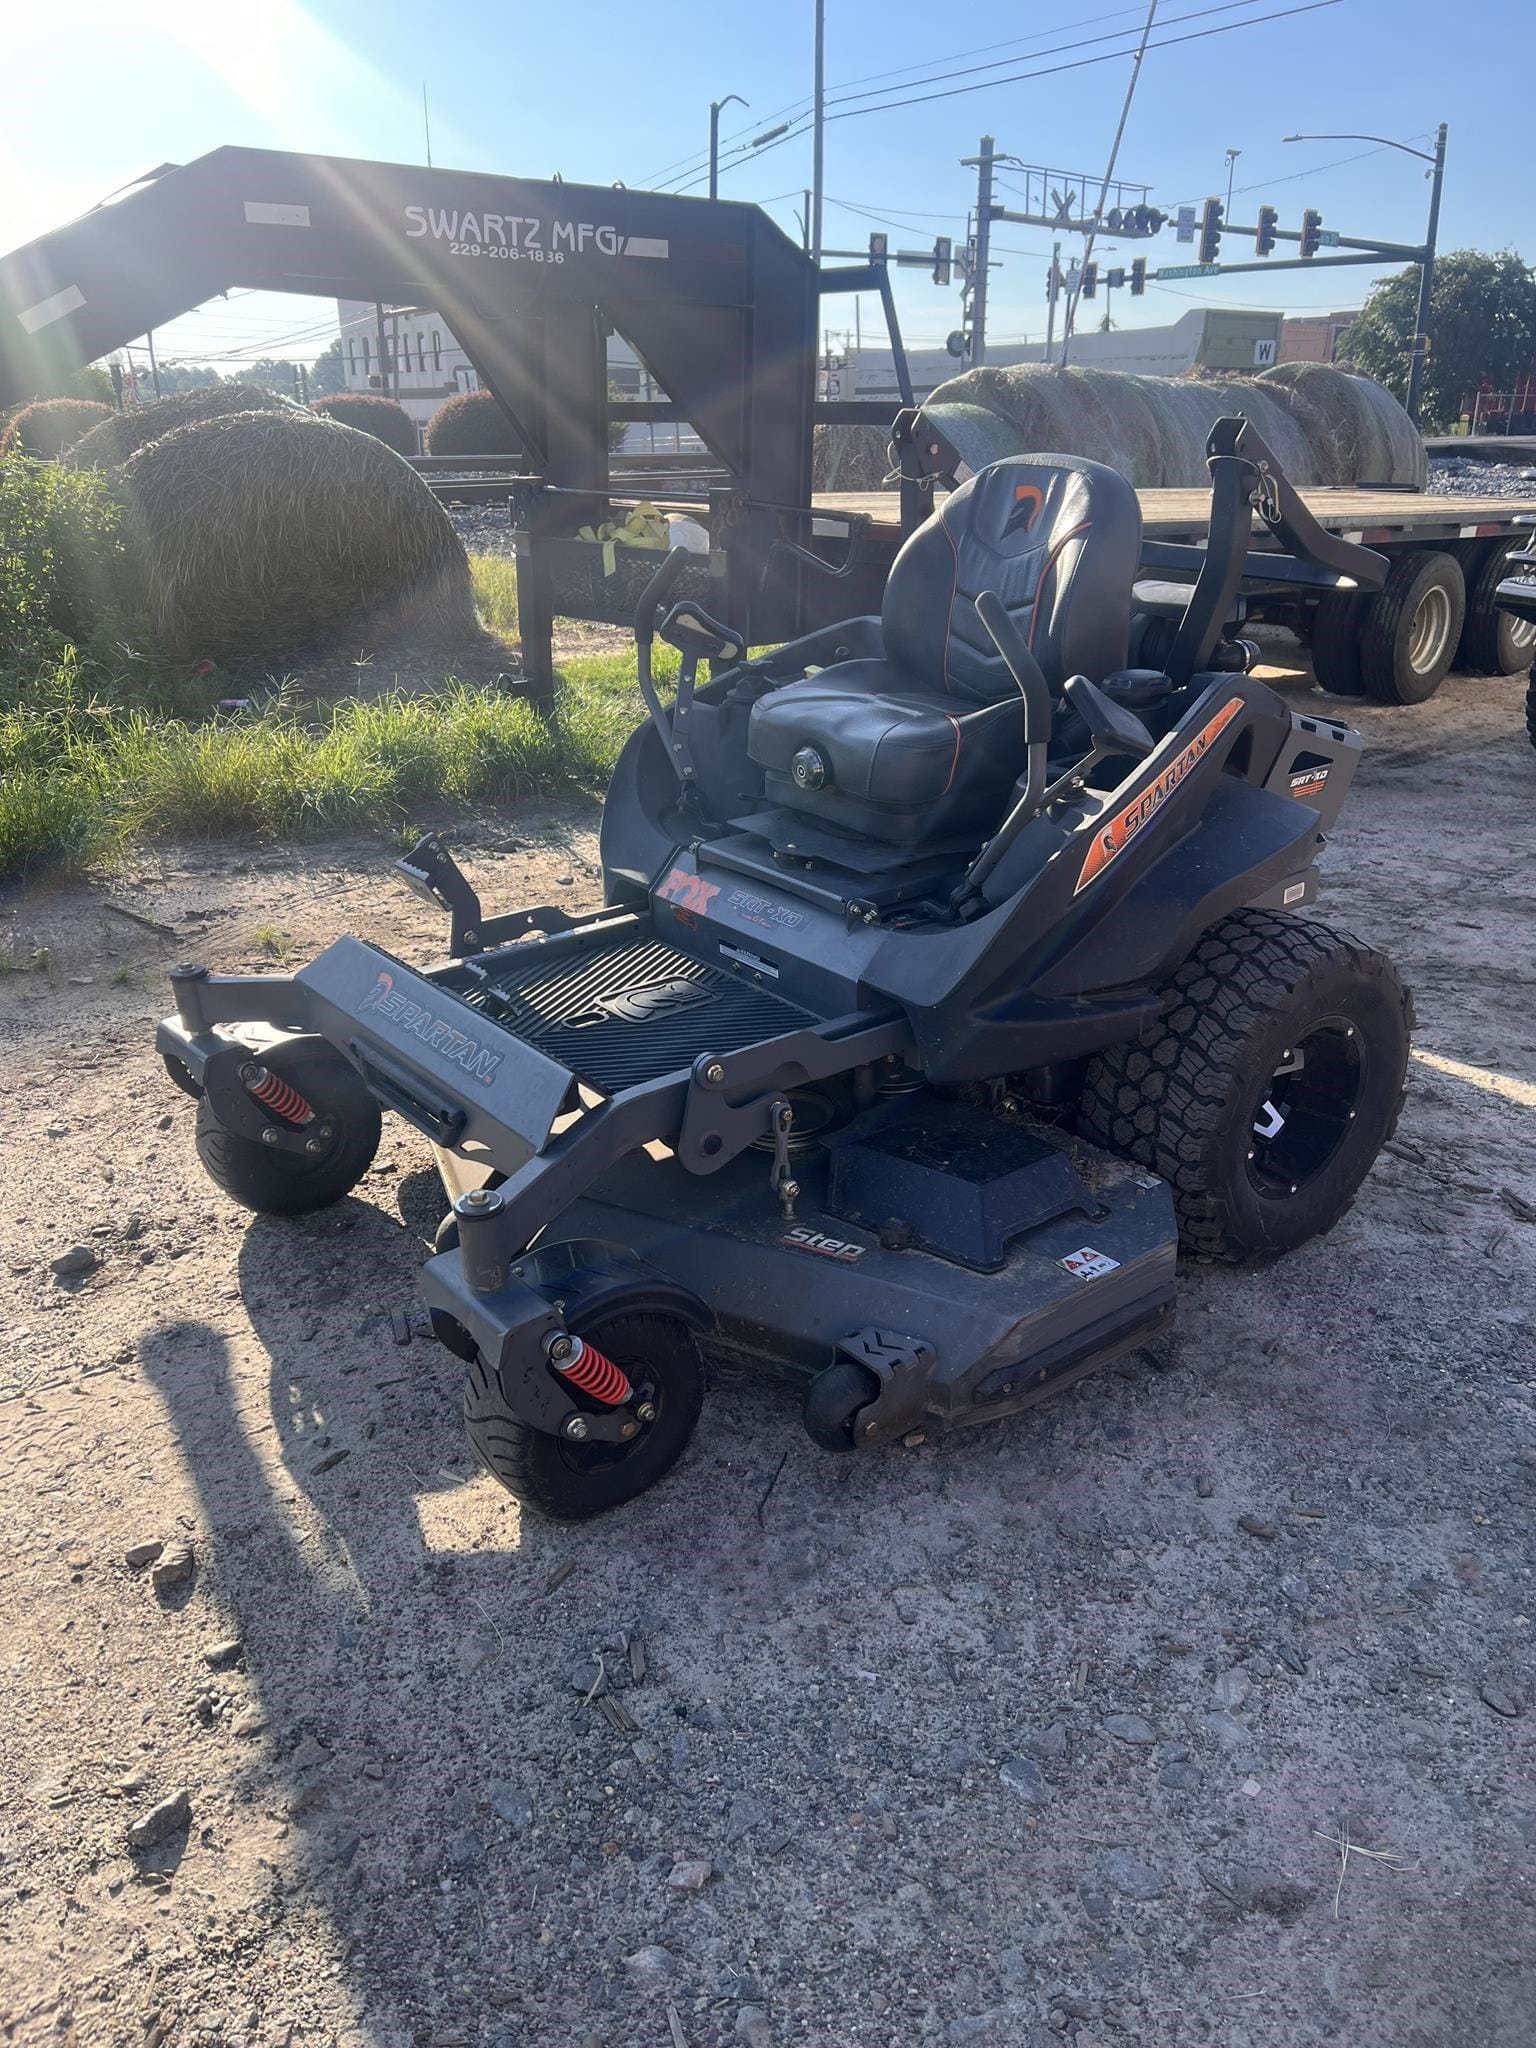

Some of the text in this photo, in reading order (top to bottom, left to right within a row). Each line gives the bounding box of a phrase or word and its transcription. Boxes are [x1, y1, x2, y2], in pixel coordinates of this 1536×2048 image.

[404, 206, 616, 256] SWARTZ MFG
[450, 242, 565, 264] 229-206-1836
[1259, 344, 1272, 361] W
[1125, 734, 1208, 841] SPARTAN
[1290, 769, 1329, 787] SRT-XD
[376, 990, 500, 1079] SPARTAN
